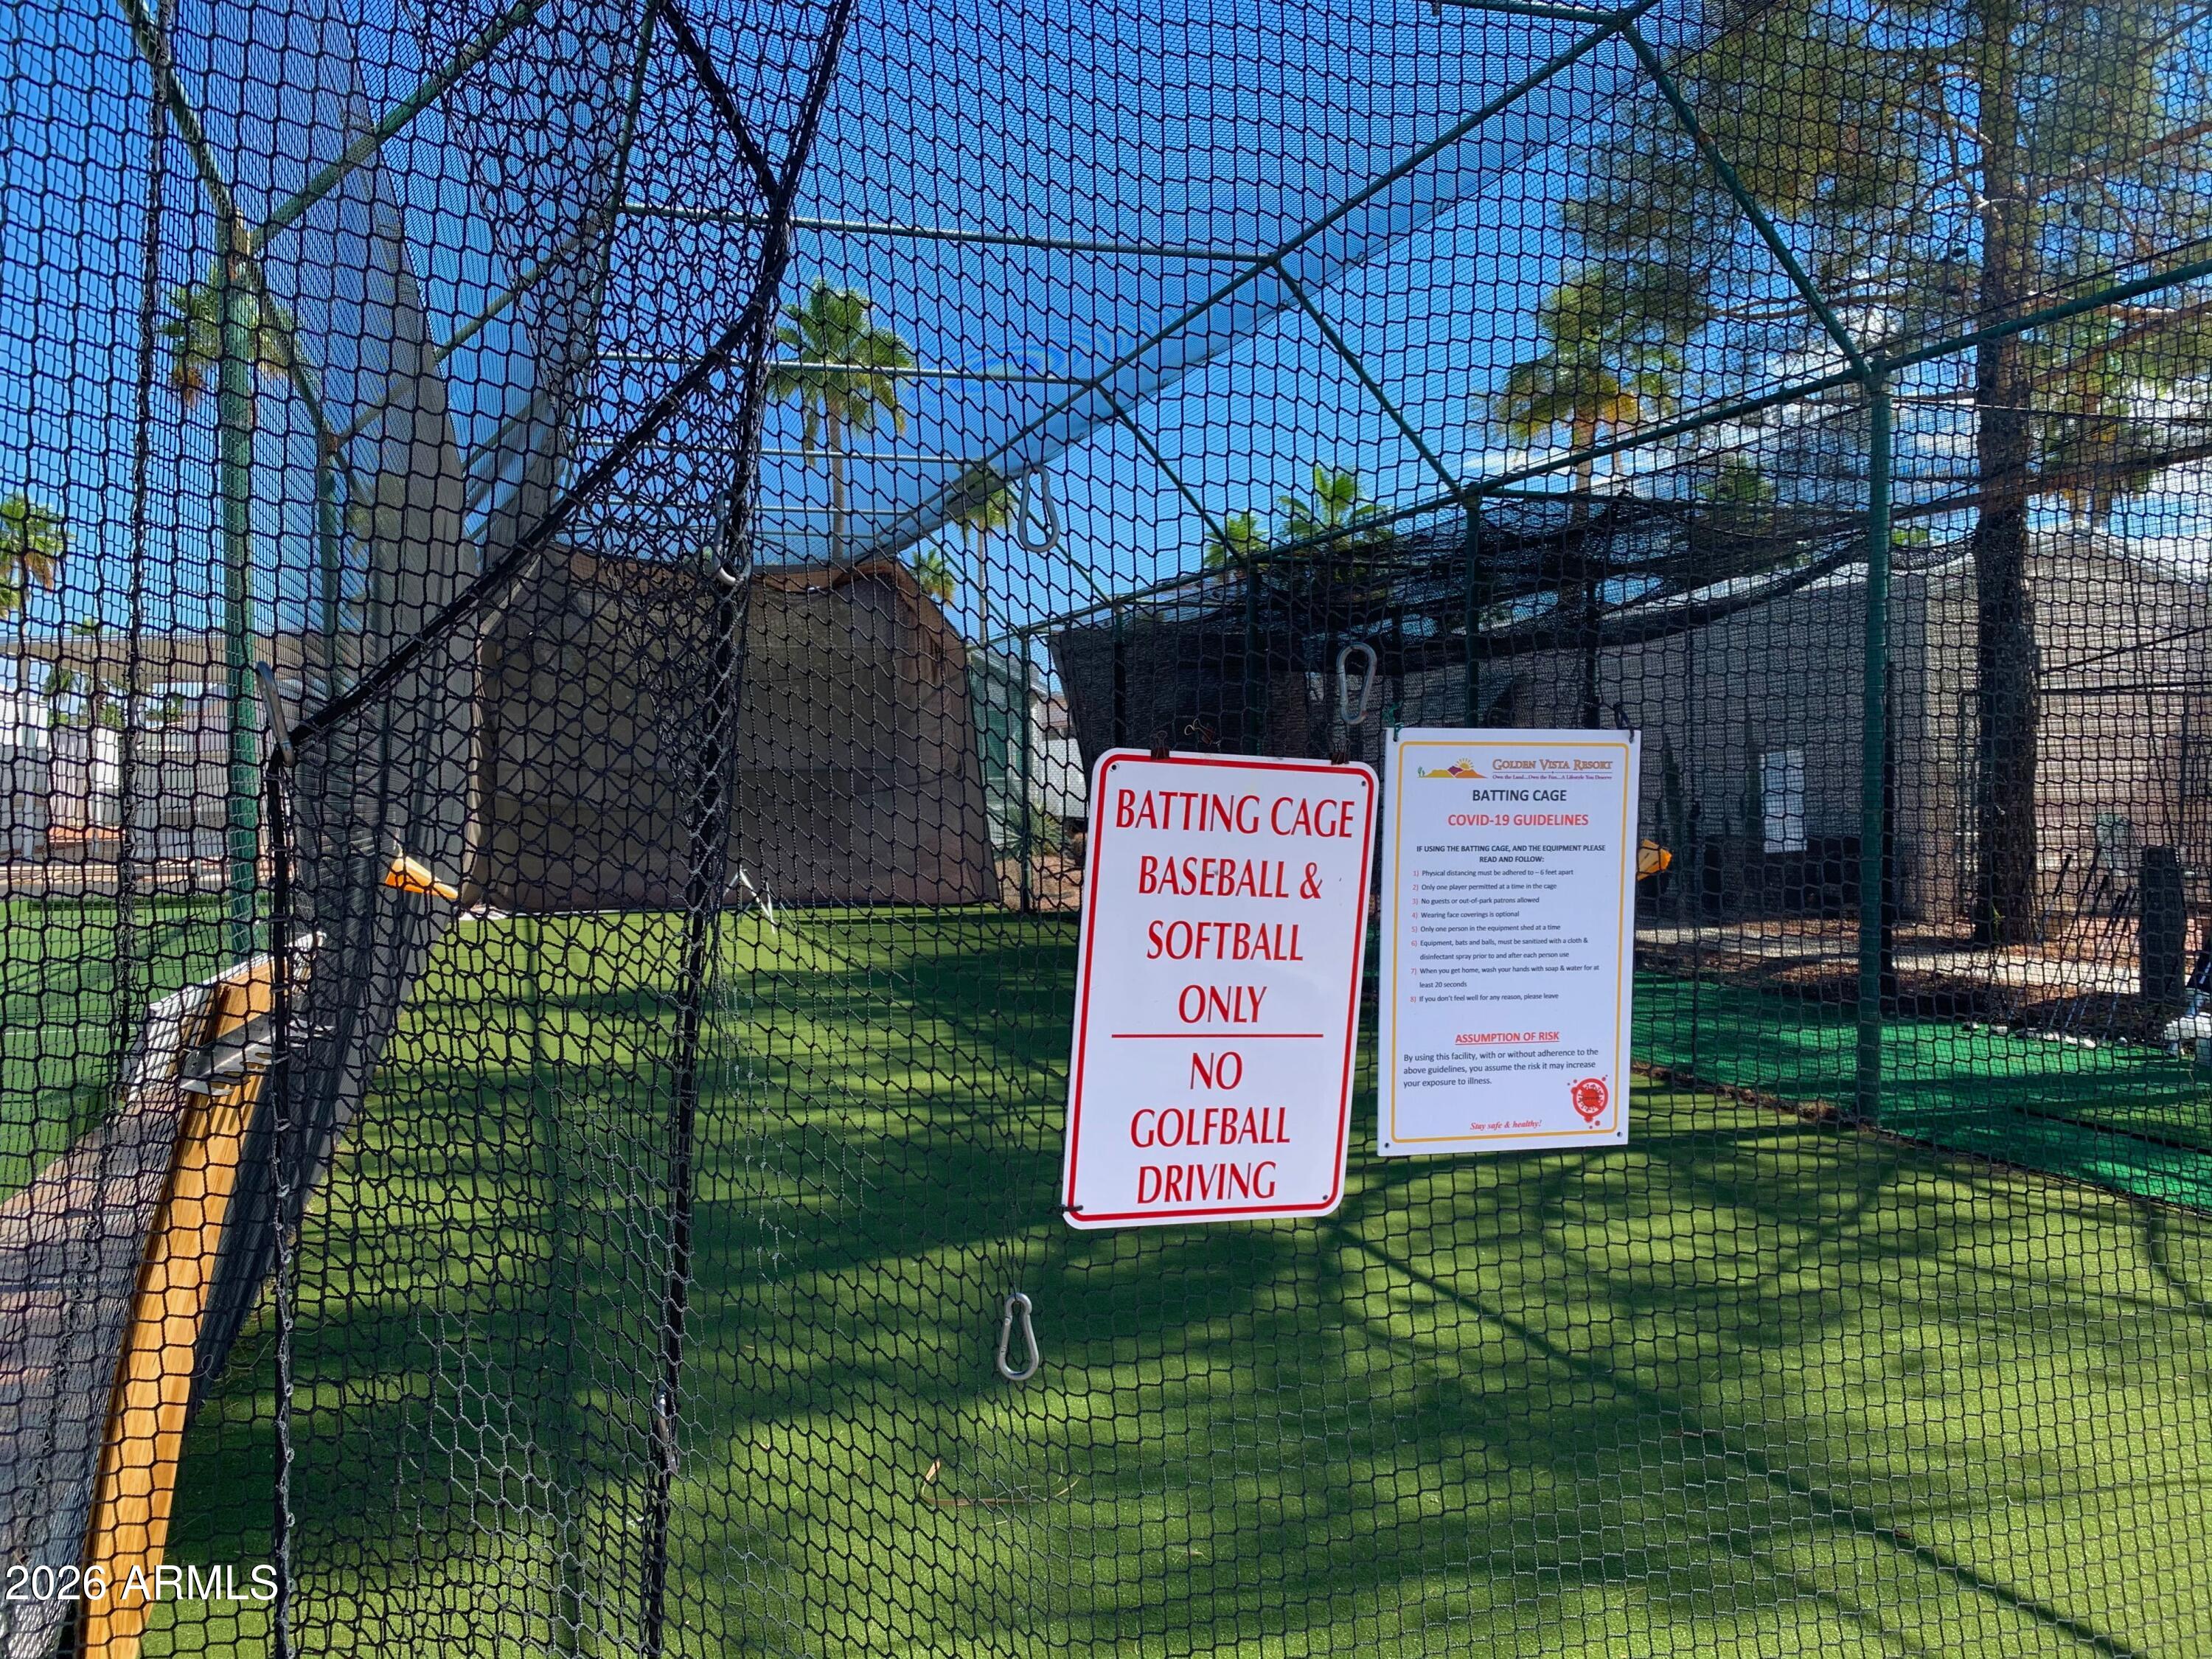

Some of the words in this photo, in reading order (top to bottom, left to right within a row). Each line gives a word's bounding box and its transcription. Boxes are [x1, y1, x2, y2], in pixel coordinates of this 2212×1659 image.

[1472, 790, 1528, 801] BATTING
[1533, 790, 1567, 801] CAGE
[1116, 788, 1260, 834] BATTING
[1270, 796, 1355, 838] CAGE
[1448, 814, 1509, 826] COVID-19
[1513, 815, 1588, 826] GUIDELINES
[1138, 855, 1289, 898] BASEBALL
[1299, 862, 1323, 900] &
[1147, 920, 1303, 961] SOFTBALL
[1179, 984, 1267, 1023] ONLY
[1455, 1032, 1520, 1043] ASSUMPTION
[1523, 1032, 1536, 1040] OF
[1539, 1032, 1559, 1040] RISK
[1451, 1052, 1478, 1060] facility,
[1190, 1051, 1242, 1090] NO
[1428, 1065, 1467, 1074] guidelines,
[1469, 1065, 1482, 1074] you
[1404, 1080, 1420, 1088] your
[1422, 1079, 1455, 1087] exposure
[1130, 1107, 1290, 1148] GOLFBALL
[1470, 1122, 1486, 1131] Stay
[1487, 1121, 1502, 1130] safe
[1512, 1120, 1542, 1129] healthy!
[1138, 1161, 1276, 1204] DRIVING
